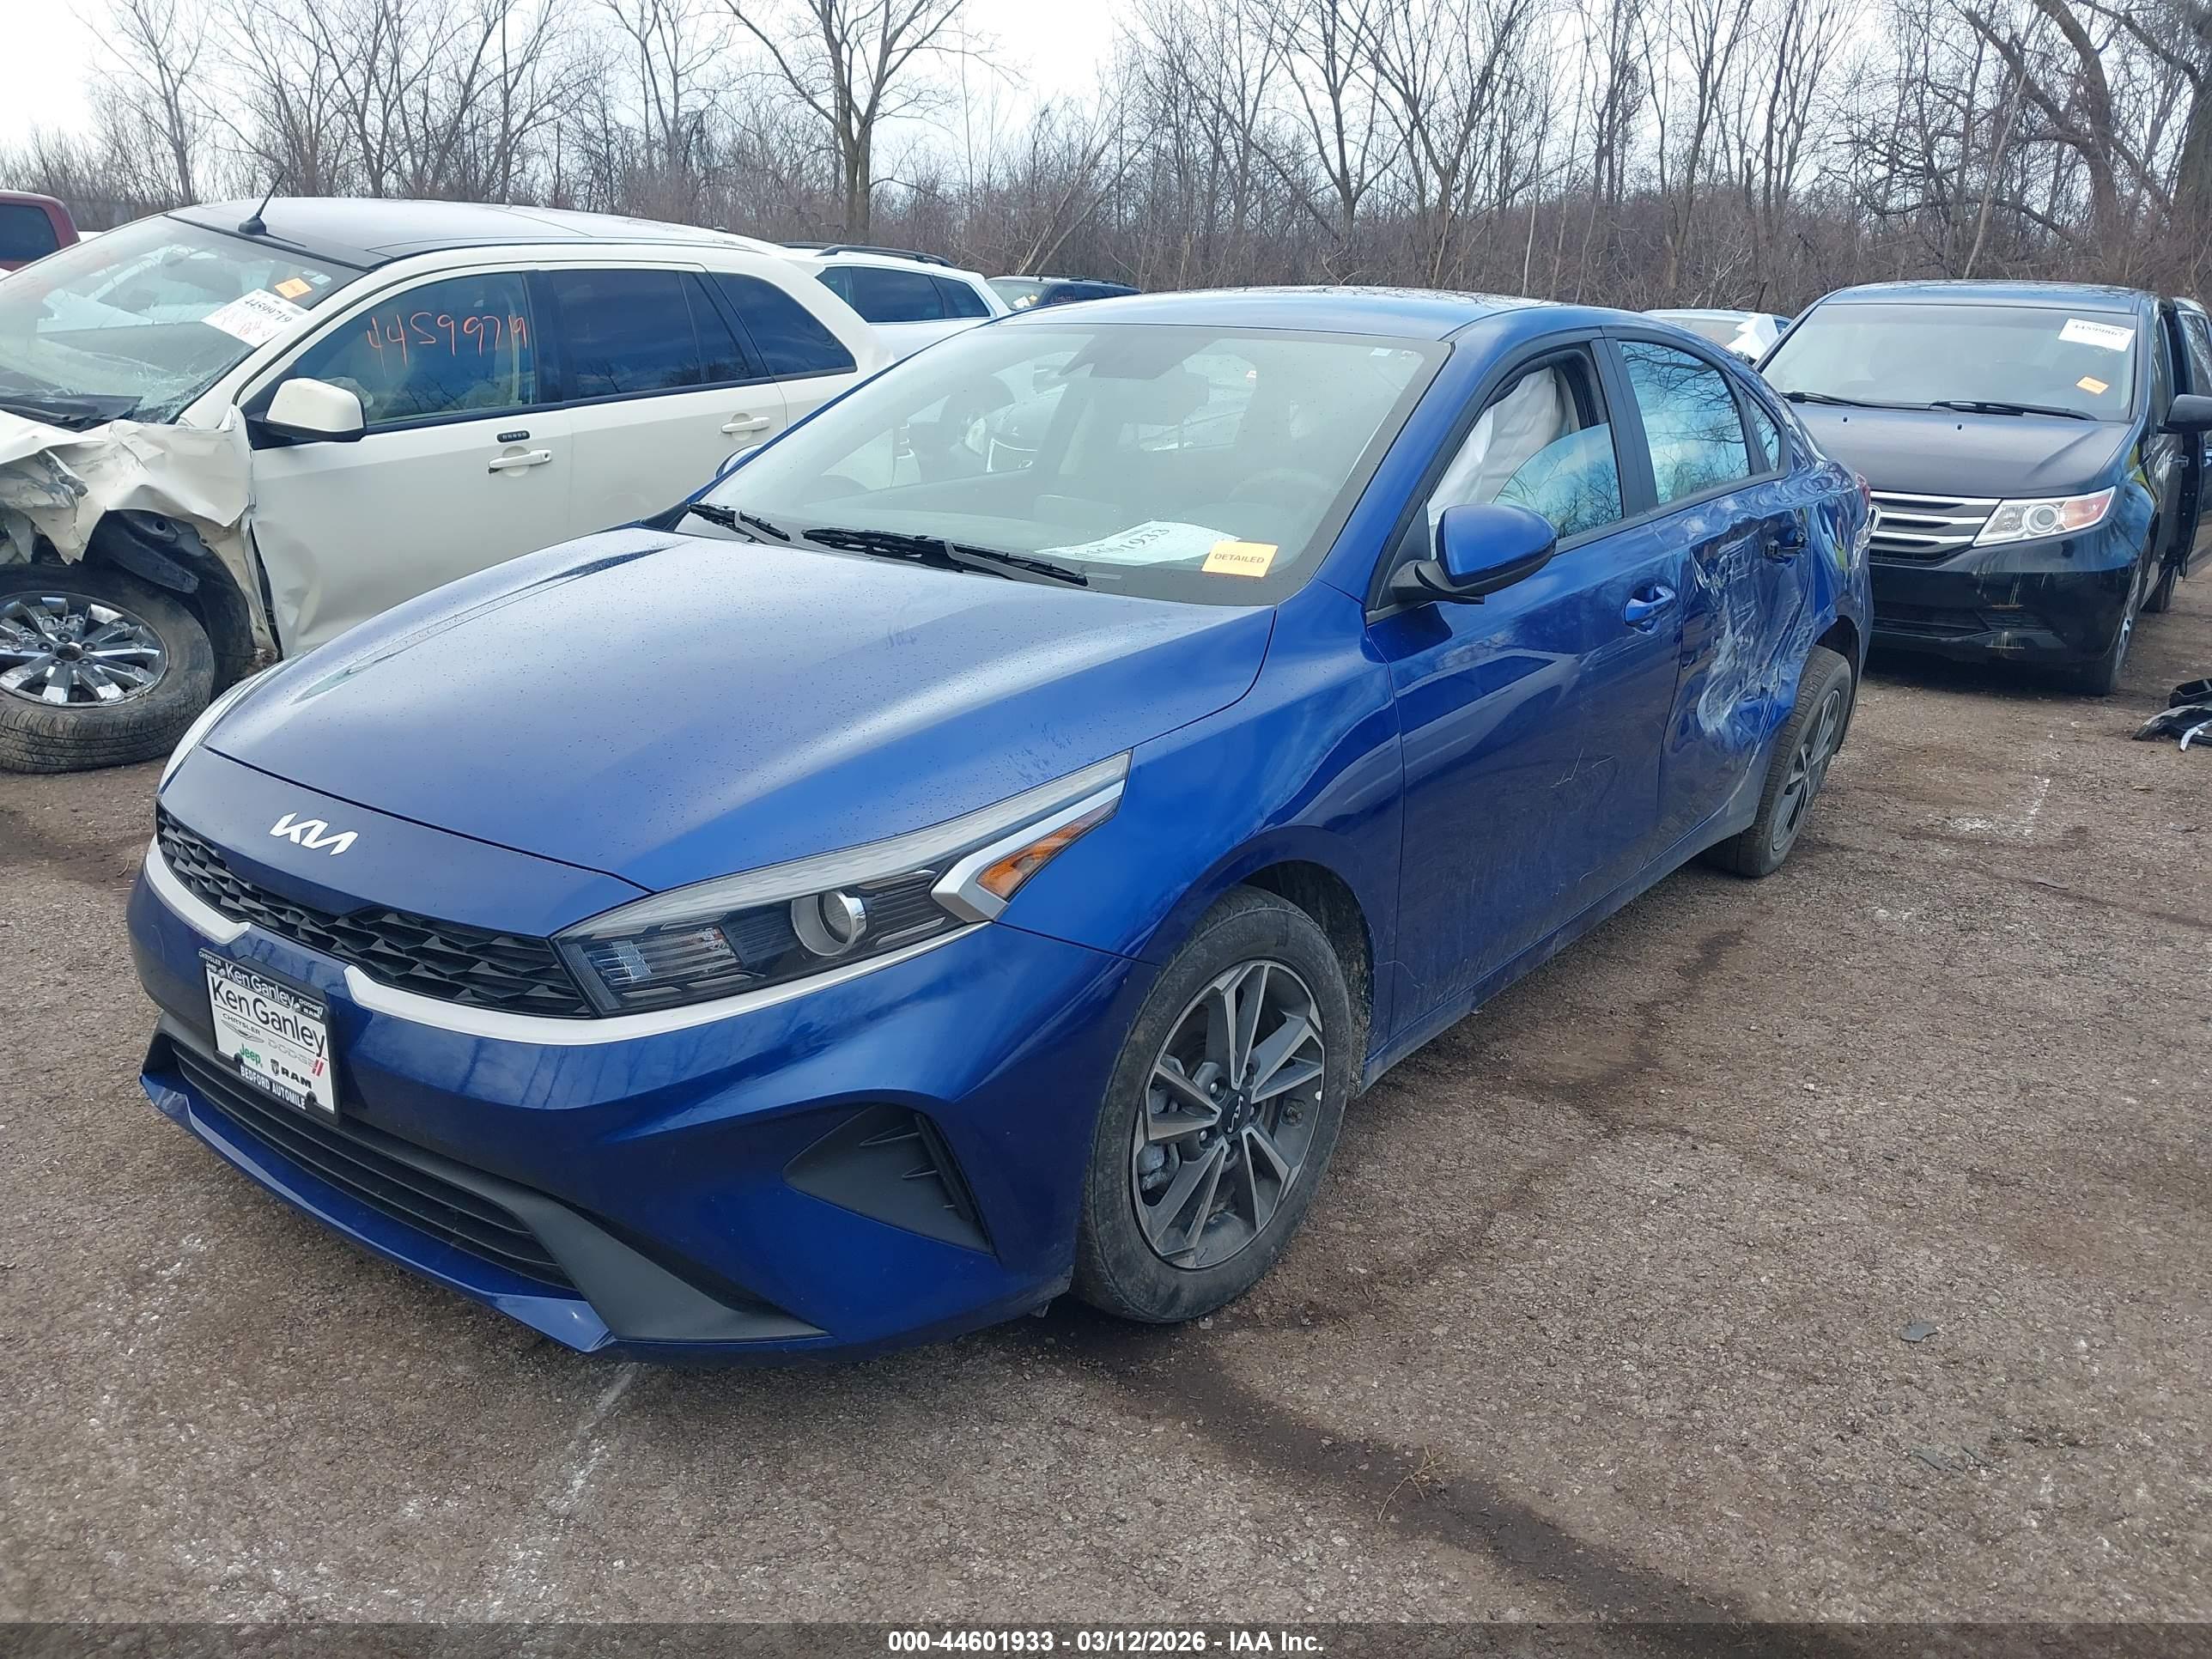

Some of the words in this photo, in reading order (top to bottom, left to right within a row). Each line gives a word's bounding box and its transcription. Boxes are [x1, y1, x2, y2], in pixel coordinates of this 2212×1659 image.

[1213, 552, 1266, 564] DETAILED
[269, 812, 359, 856] KIA
[225, 963, 251, 988] Ken
[251, 975, 295, 1010] Ganley
[210, 975, 252, 1018] Ken
[252, 997, 325, 1058] Ganley
[222, 1012, 261, 1036] CHRYSLER
[239, 1042, 261, 1066] Jeep
[267, 1038, 317, 1068] DODGE
[240, 1065, 270, 1091] BEDFORD
[271, 1085, 307, 1110] AUTOMILE
[281, 1067, 313, 1090] RAM
